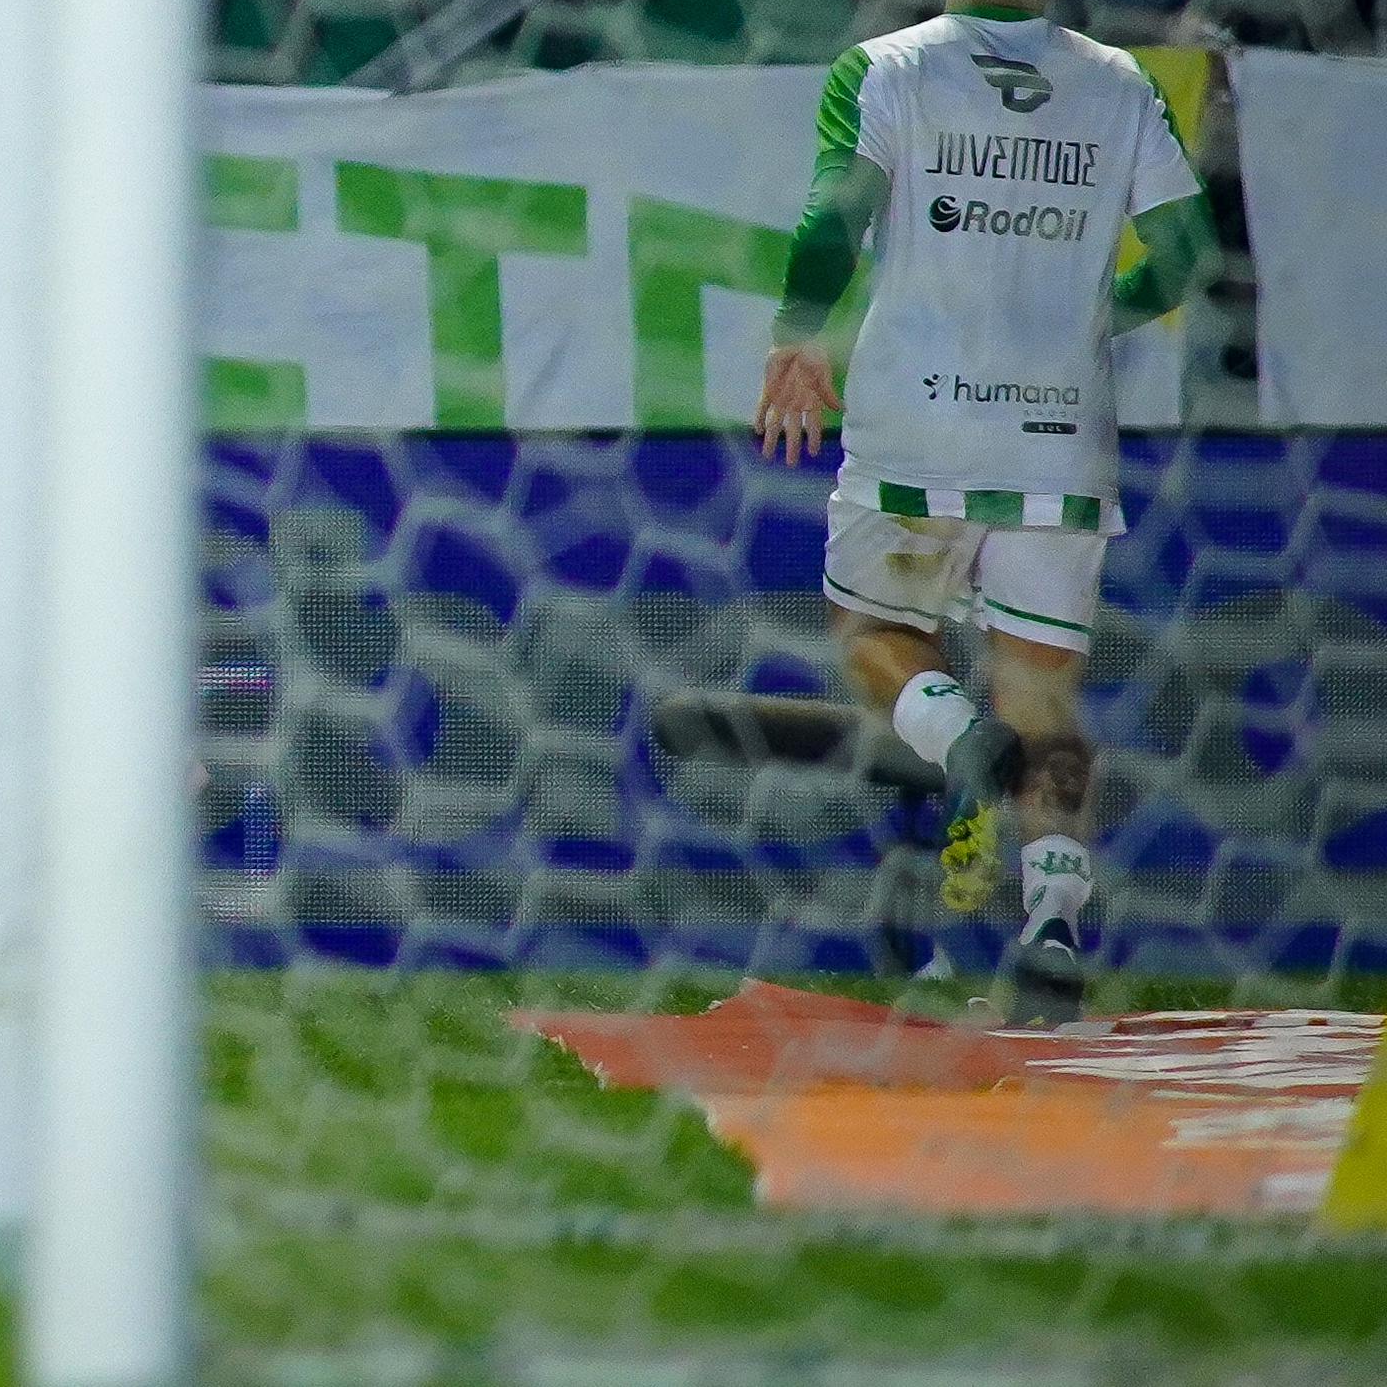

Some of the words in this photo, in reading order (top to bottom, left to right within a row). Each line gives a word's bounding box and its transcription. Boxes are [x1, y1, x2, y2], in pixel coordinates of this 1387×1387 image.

[924, 131, 1100, 188] JUVENTUDE
[962, 199, 1088, 243] RodOil
[954, 374, 1081, 406] humana
